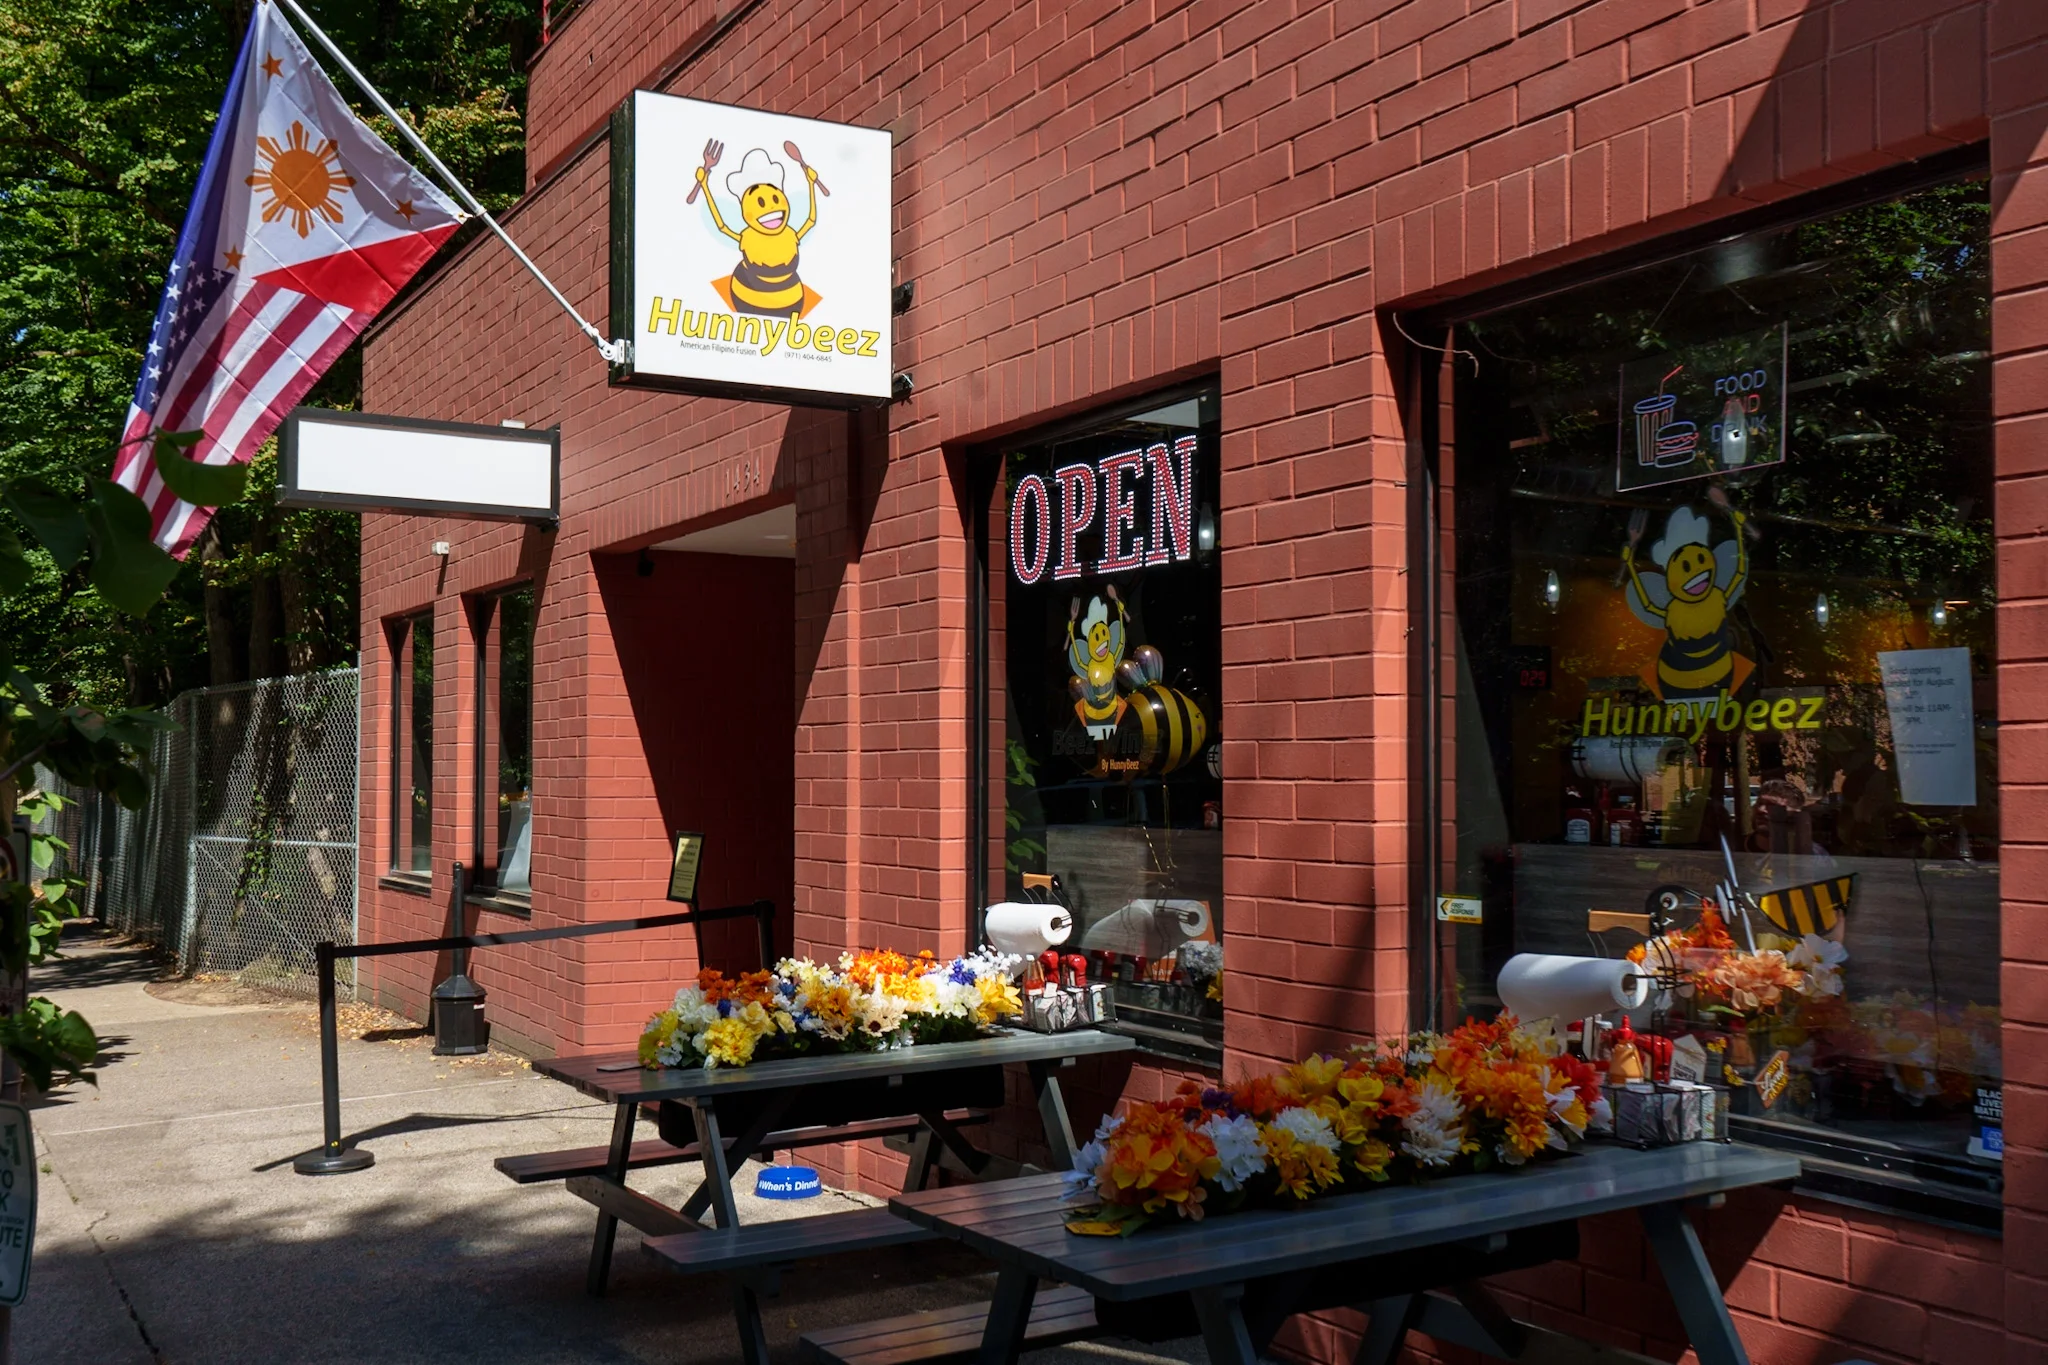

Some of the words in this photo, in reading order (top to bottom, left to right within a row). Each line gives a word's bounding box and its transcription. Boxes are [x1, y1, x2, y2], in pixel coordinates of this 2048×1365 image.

[648, 296, 881, 357] Hunnybeez
[680, 340, 711, 351] American
[711, 343, 735, 355] Filipino
[736, 346, 757, 356] Fusion
[784, 351, 801, 360] (971)
[1714, 369, 1767, 397] FOOD
[1711, 414, 1767, 443] DRNK
[1011, 435, 1198, 584] OPEN
[1582, 690, 1826, 745] Hunnybeez
[1101, 758, 1109, 772] By
[1976, 1088, 2003, 1100] BLAC
[1973, 1105, 2004, 1118] MATT
[1979, 1098, 2003, 1109] LIVE
